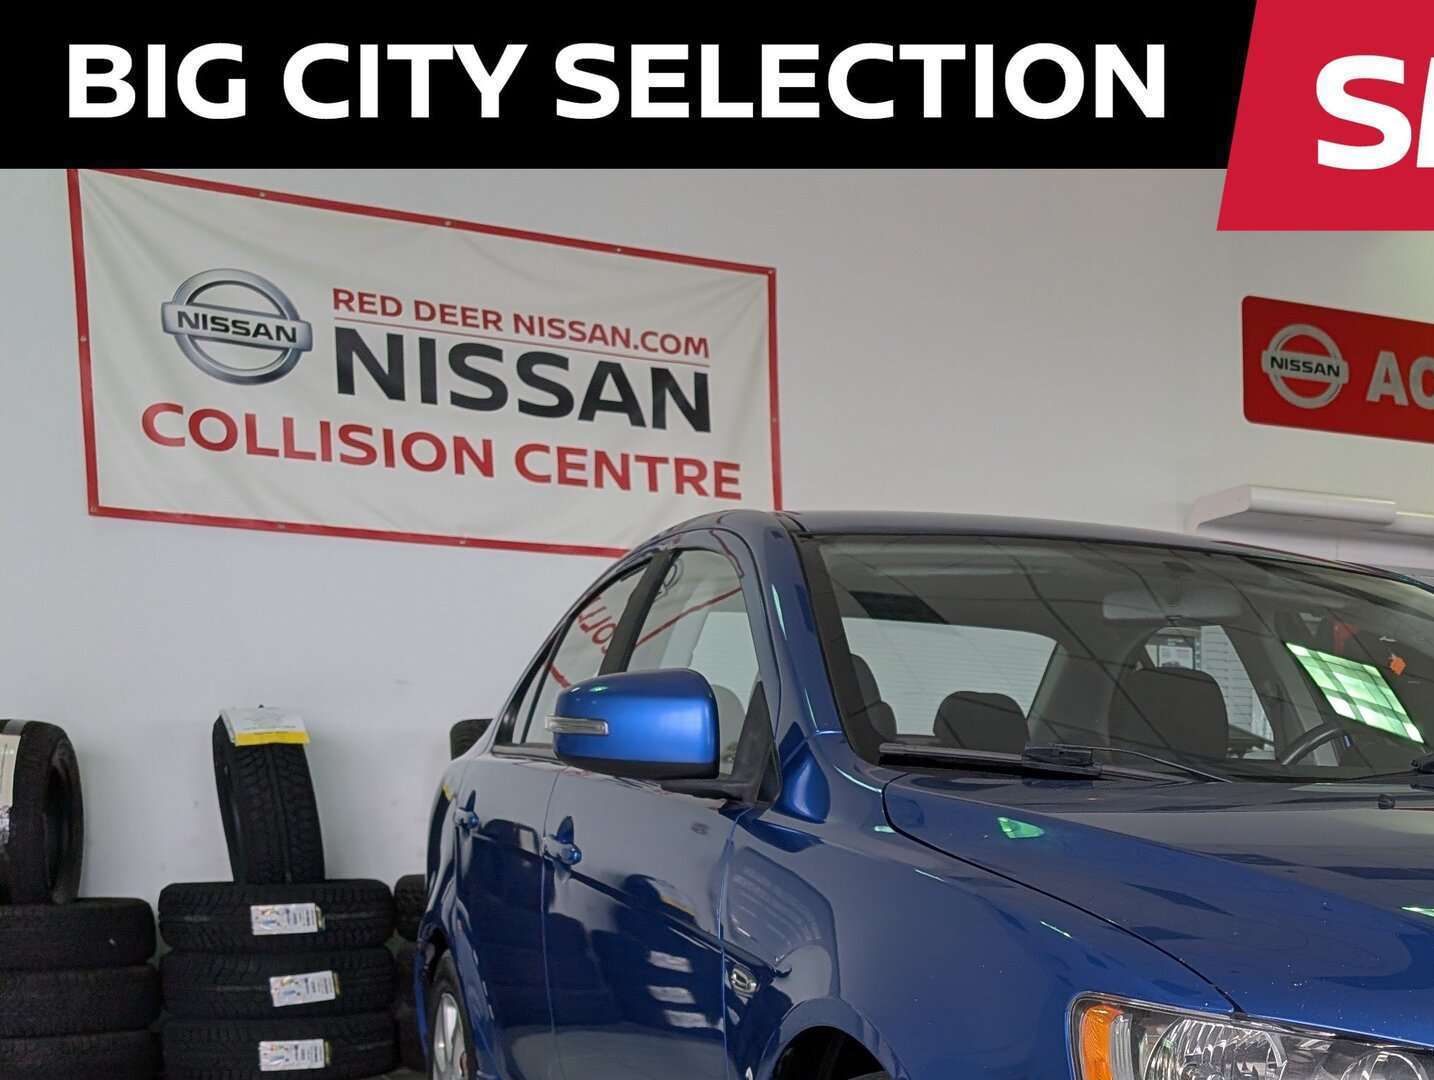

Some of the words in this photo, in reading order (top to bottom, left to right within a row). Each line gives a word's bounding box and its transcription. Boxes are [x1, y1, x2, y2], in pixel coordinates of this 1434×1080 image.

[176, 309, 298, 344] NISSAN
[333, 287, 402, 318] RED
[414, 298, 503, 332] DEER
[512, 313, 710, 358] NISSAN.COM
[334, 326, 712, 433] NISSAN
[1269, 356, 1341, 378] NISSAN
[141, 402, 494, 478] COLLISION
[515, 442, 742, 500] CENTRE
